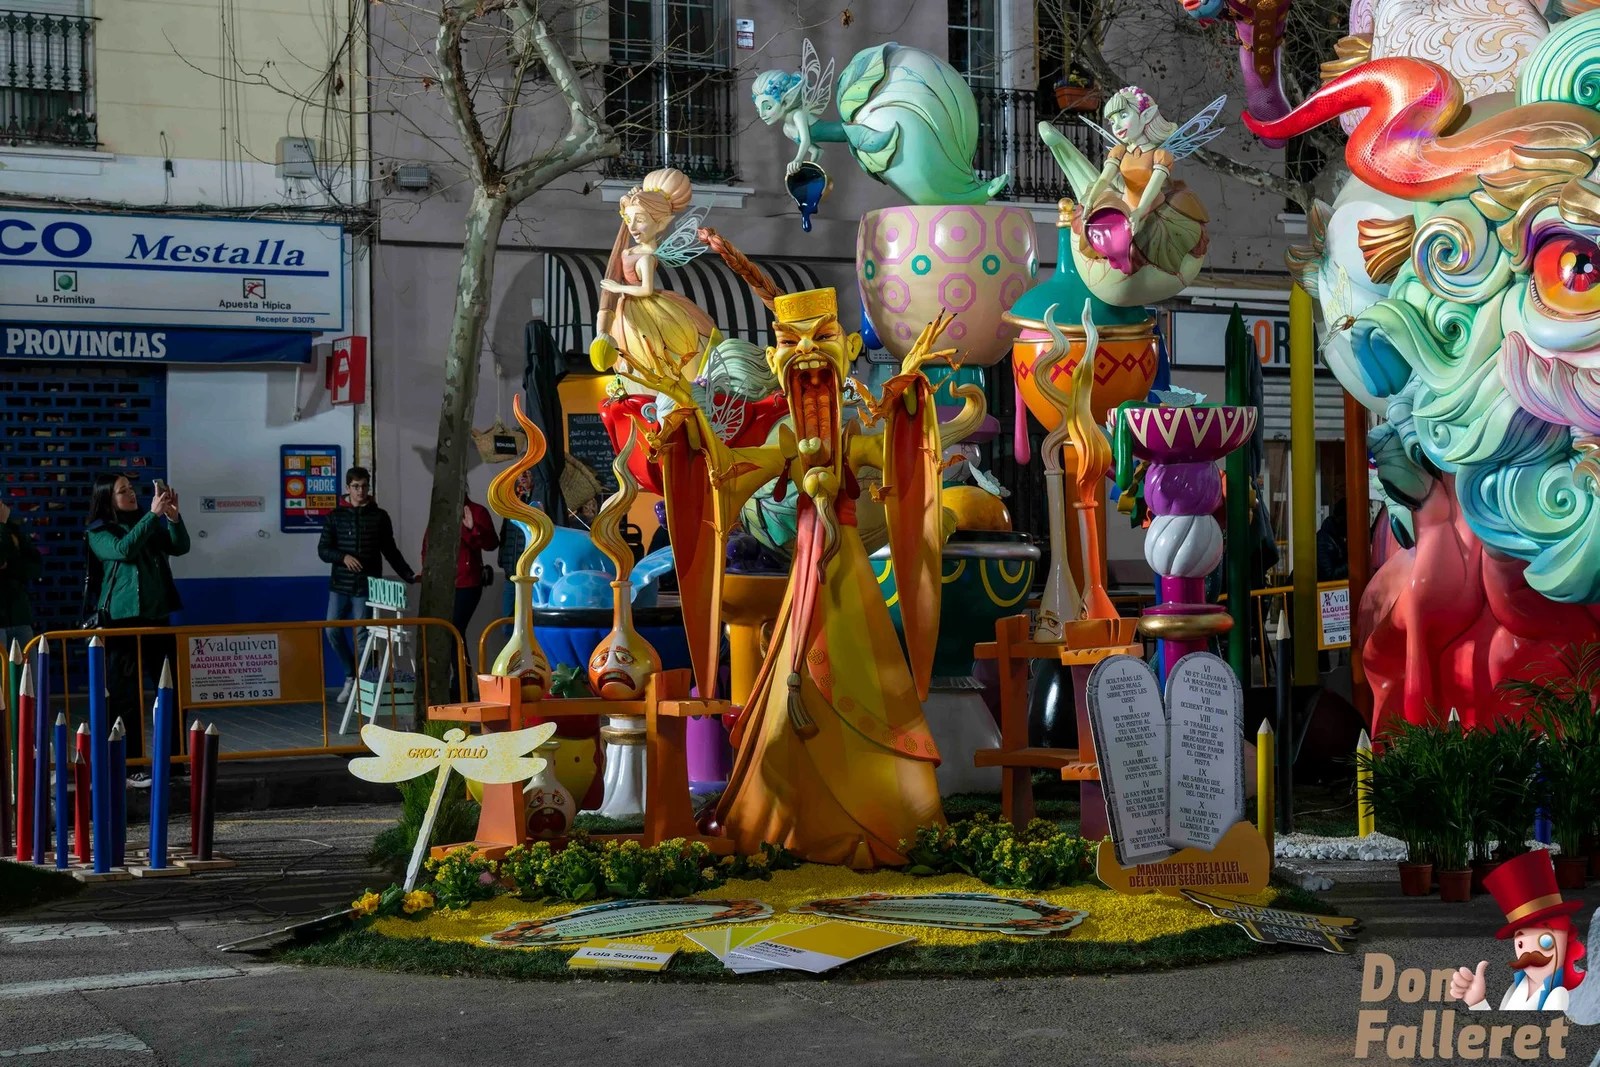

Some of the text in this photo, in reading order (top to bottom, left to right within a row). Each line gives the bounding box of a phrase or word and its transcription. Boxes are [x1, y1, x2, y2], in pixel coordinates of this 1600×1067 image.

[126, 234, 305, 266] Mestalla
[36, 294, 95, 304] La Primitiva
[219, 300, 258, 309] Apuesta
[6, 328, 166, 358] PROVINCIAS
[308, 479, 335, 492] PADRE
[367, 576, 406, 609] BONJOUR
[208, 636, 276, 654] valquiven
[1200, 714, 1210, 723] VIII
[408, 748, 441, 759] GROC
[1199, 801, 1204, 809] X
[1136, 862, 1240, 876] MANAMENTS DE LA LLEI
[1130, 872, 1249, 887] DEL COVID SEGONS LA XINA
